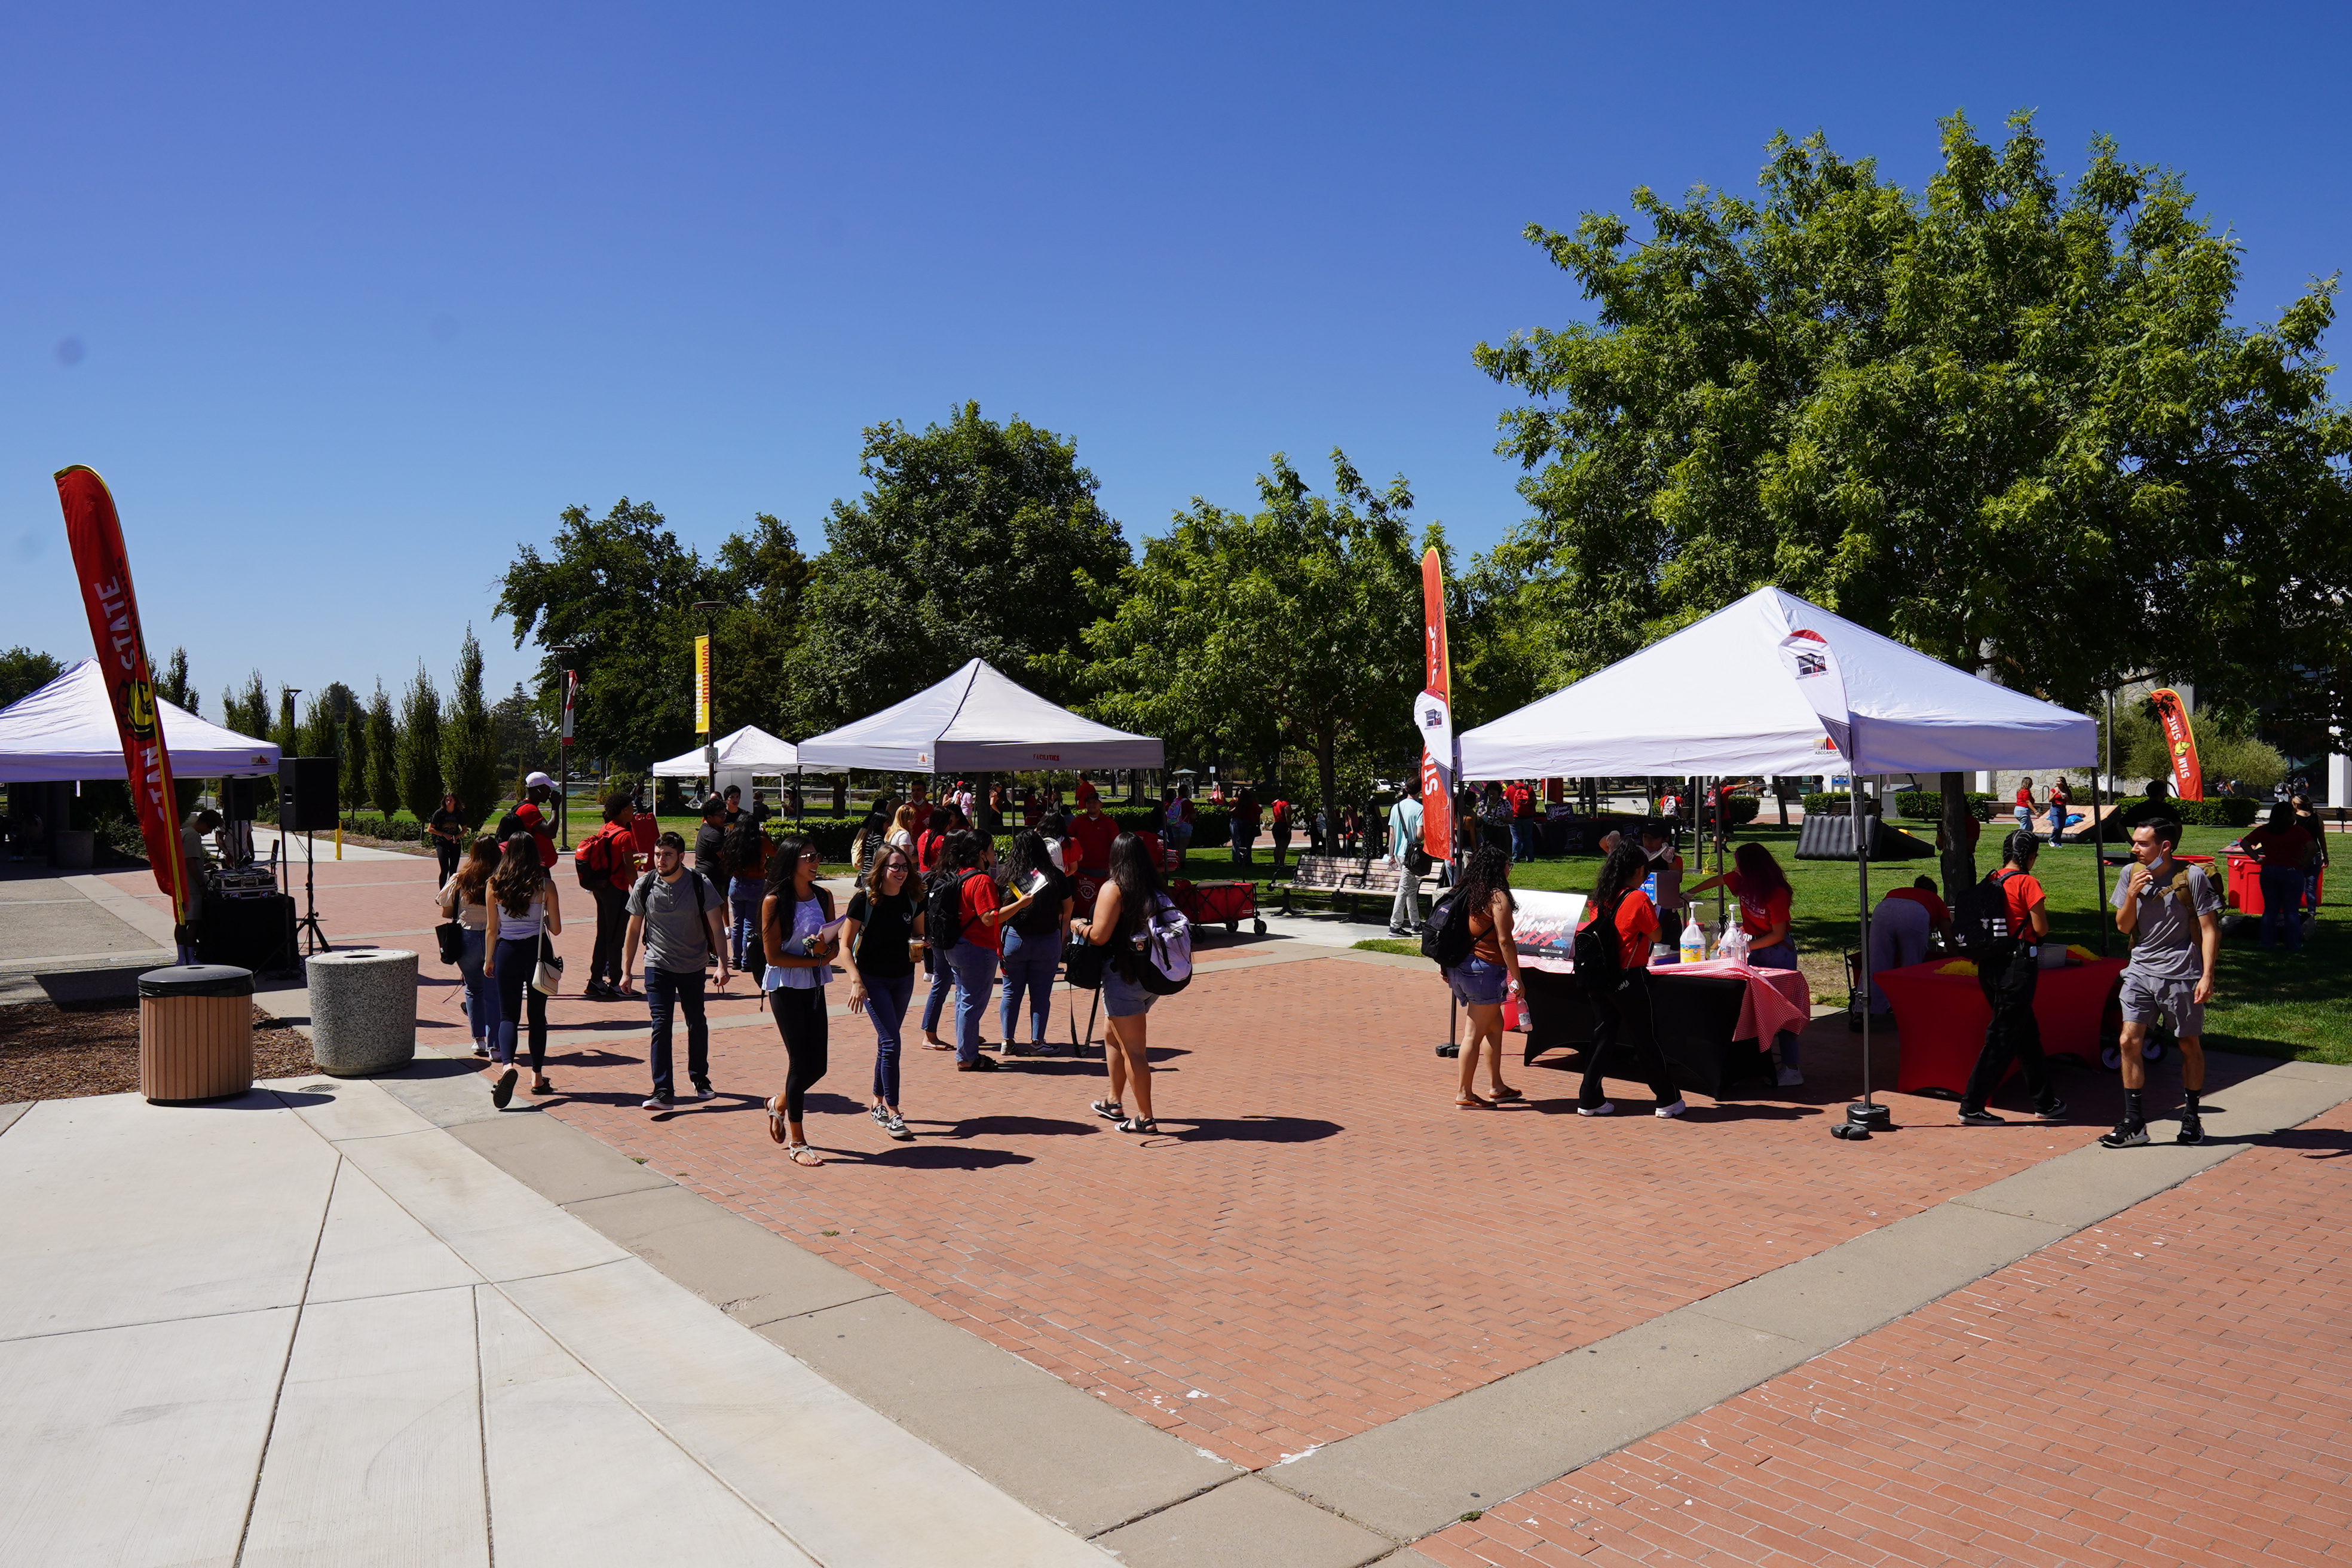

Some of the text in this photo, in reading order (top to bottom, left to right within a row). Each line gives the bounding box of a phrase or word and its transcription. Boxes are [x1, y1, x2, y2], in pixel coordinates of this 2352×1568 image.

[94, 575, 136, 670] STATE
[1424, 741, 1438, 796] STA
[2167, 715, 2190, 779] STAN STATE
[1615, 979, 1630, 992] UMA
